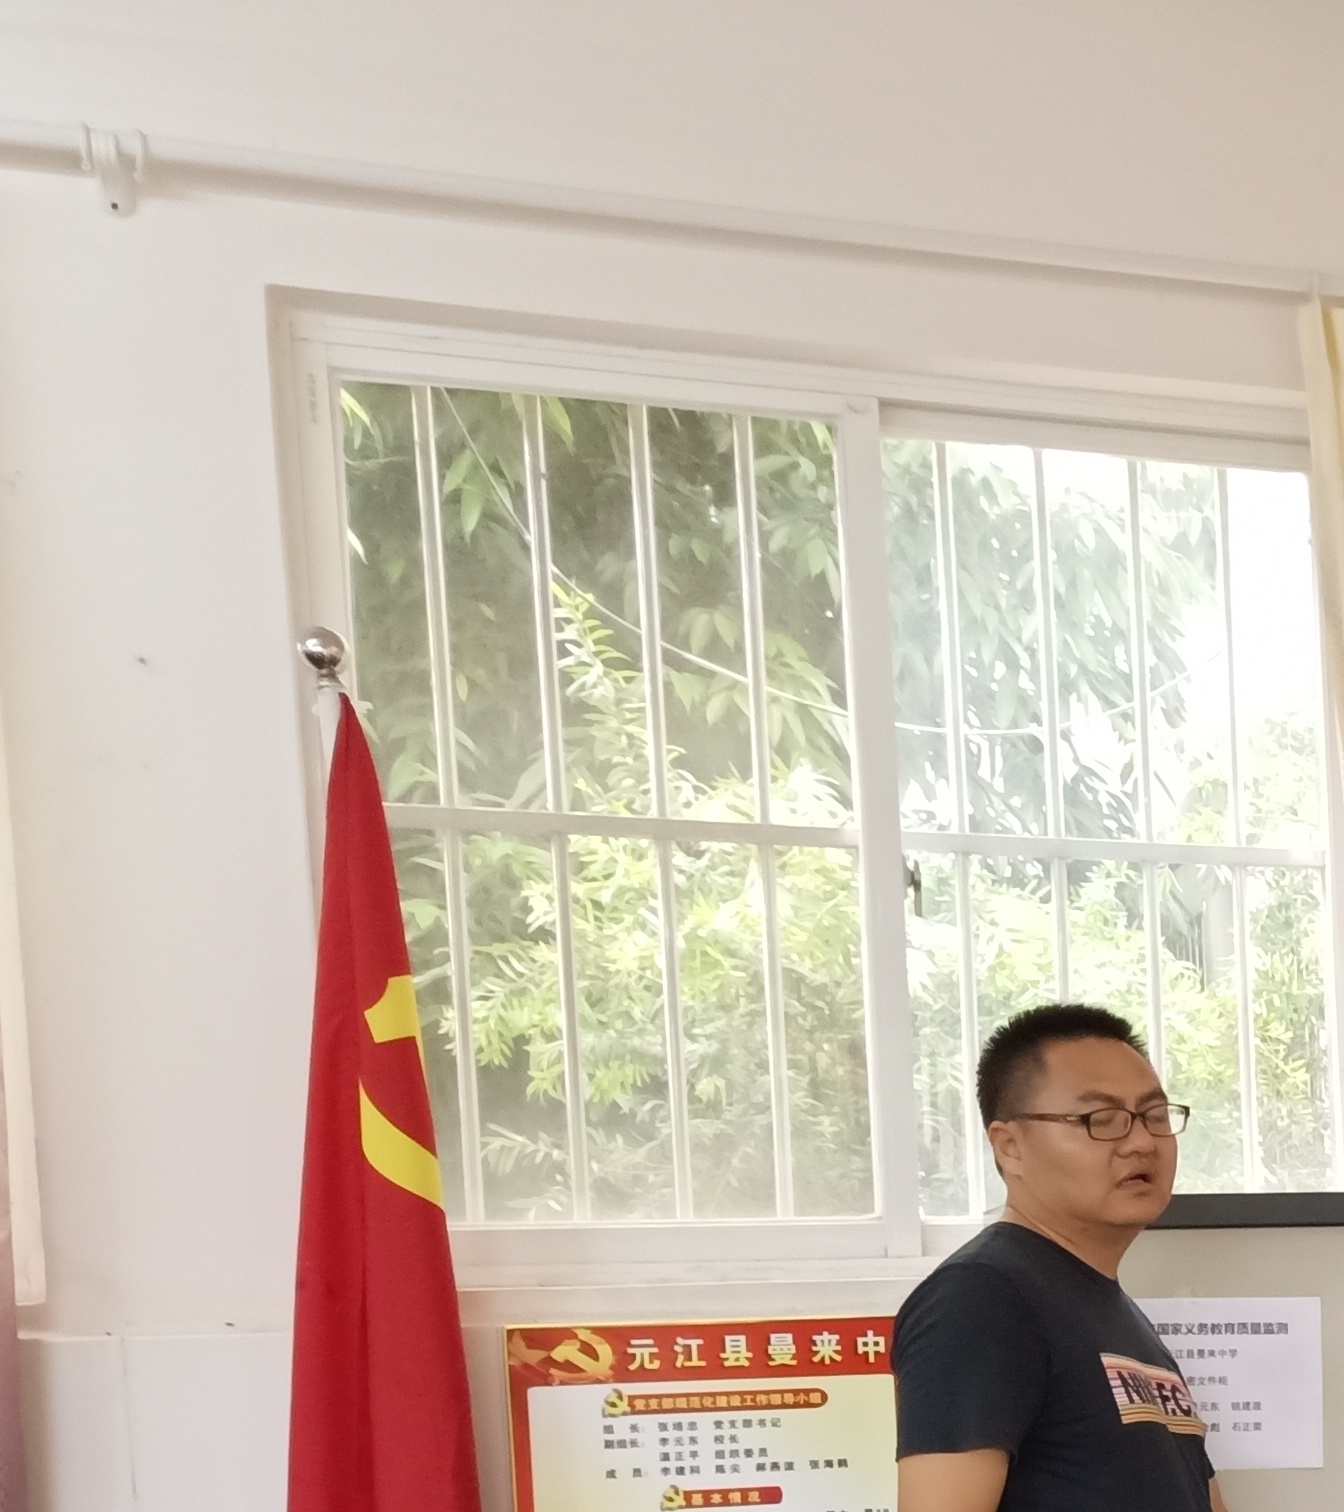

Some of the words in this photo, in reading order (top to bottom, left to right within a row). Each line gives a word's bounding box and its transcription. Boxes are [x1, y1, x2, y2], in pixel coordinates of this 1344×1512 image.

[626, 1329, 887, 1371] 元江县曼来中
[713, 1417, 782, 1430] 党支部书记
[714, 1434, 740, 1445] 校长
[714, 1447, 768, 1460] 组织委员
[691, 1490, 762, 1506] 基本情况
